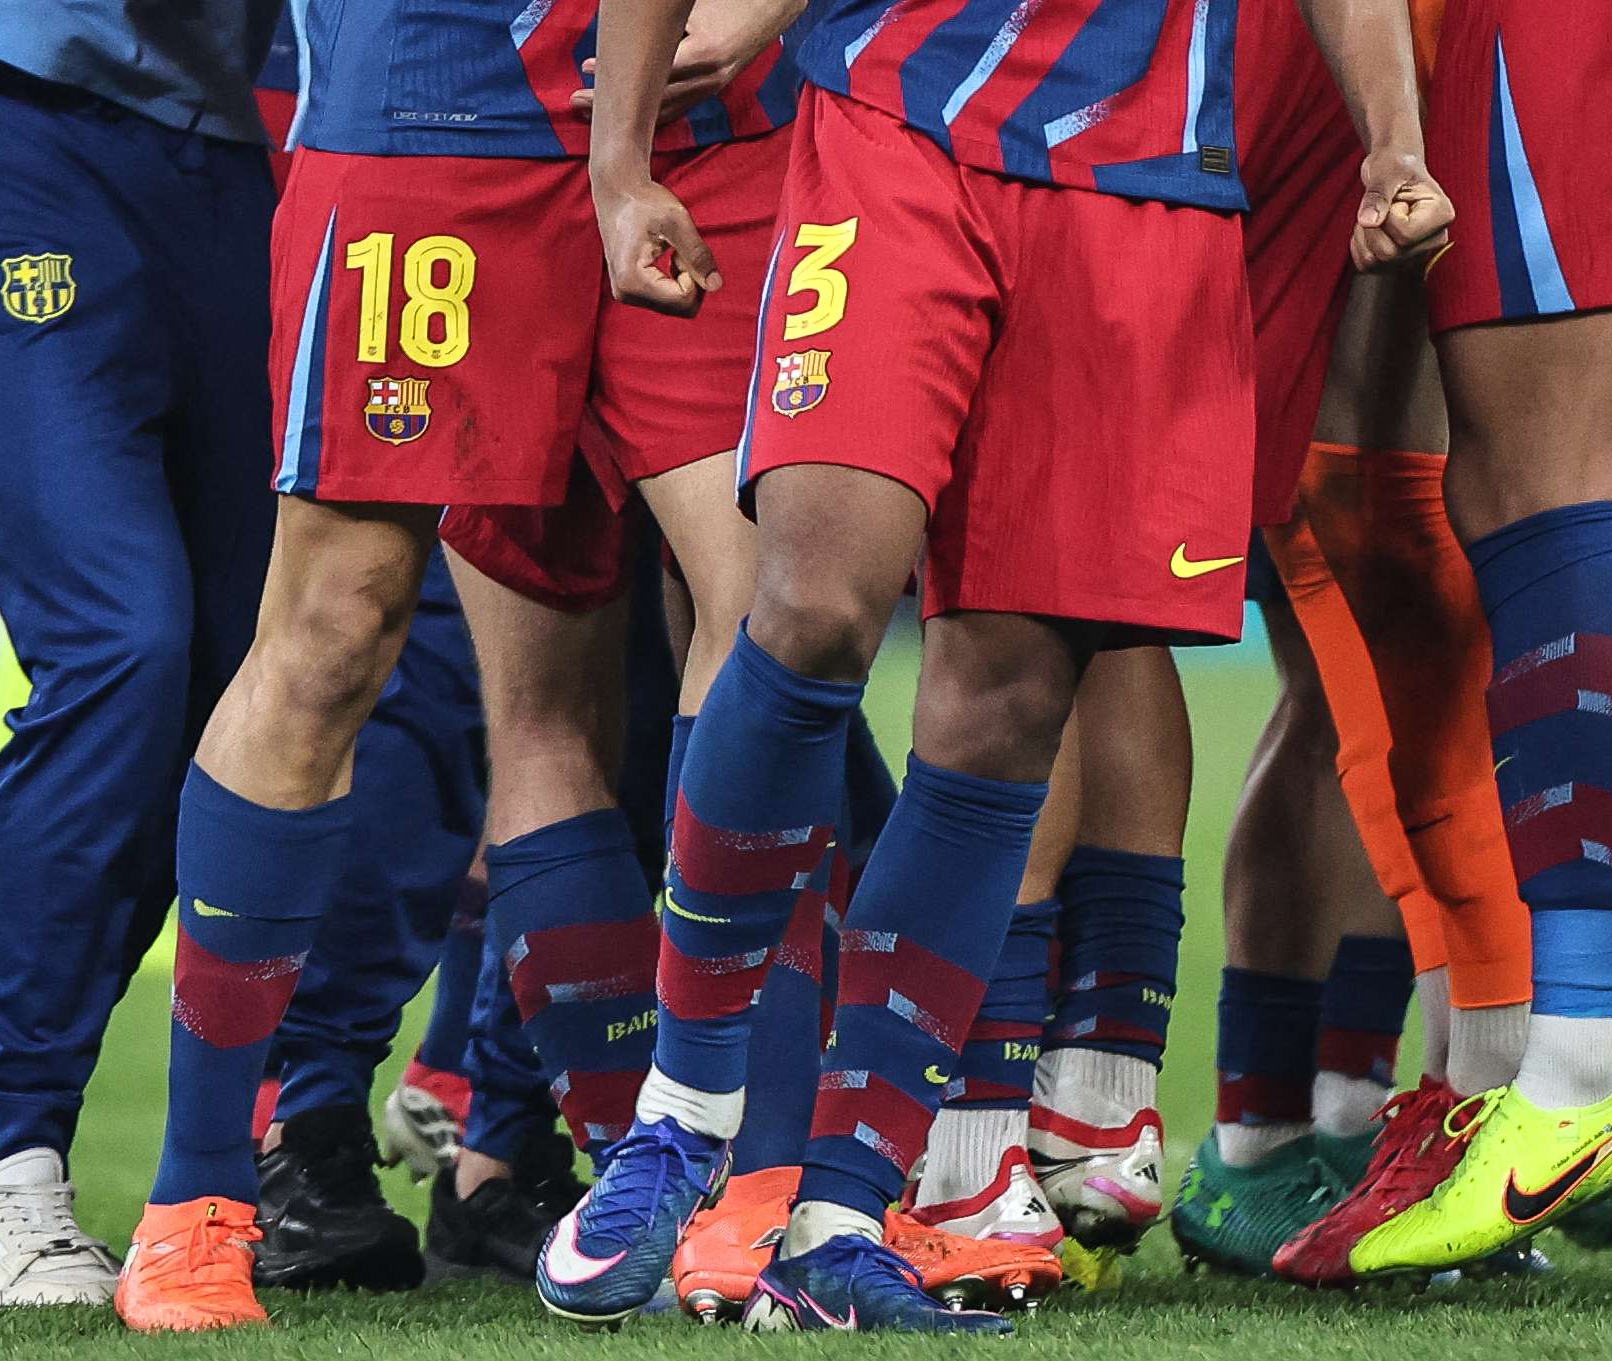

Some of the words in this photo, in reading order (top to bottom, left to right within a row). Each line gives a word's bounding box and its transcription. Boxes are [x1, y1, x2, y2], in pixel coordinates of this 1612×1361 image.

[346, 231, 478, 368] 18
[784, 216, 860, 341] 3
[384, 404, 411, 414] FCB
